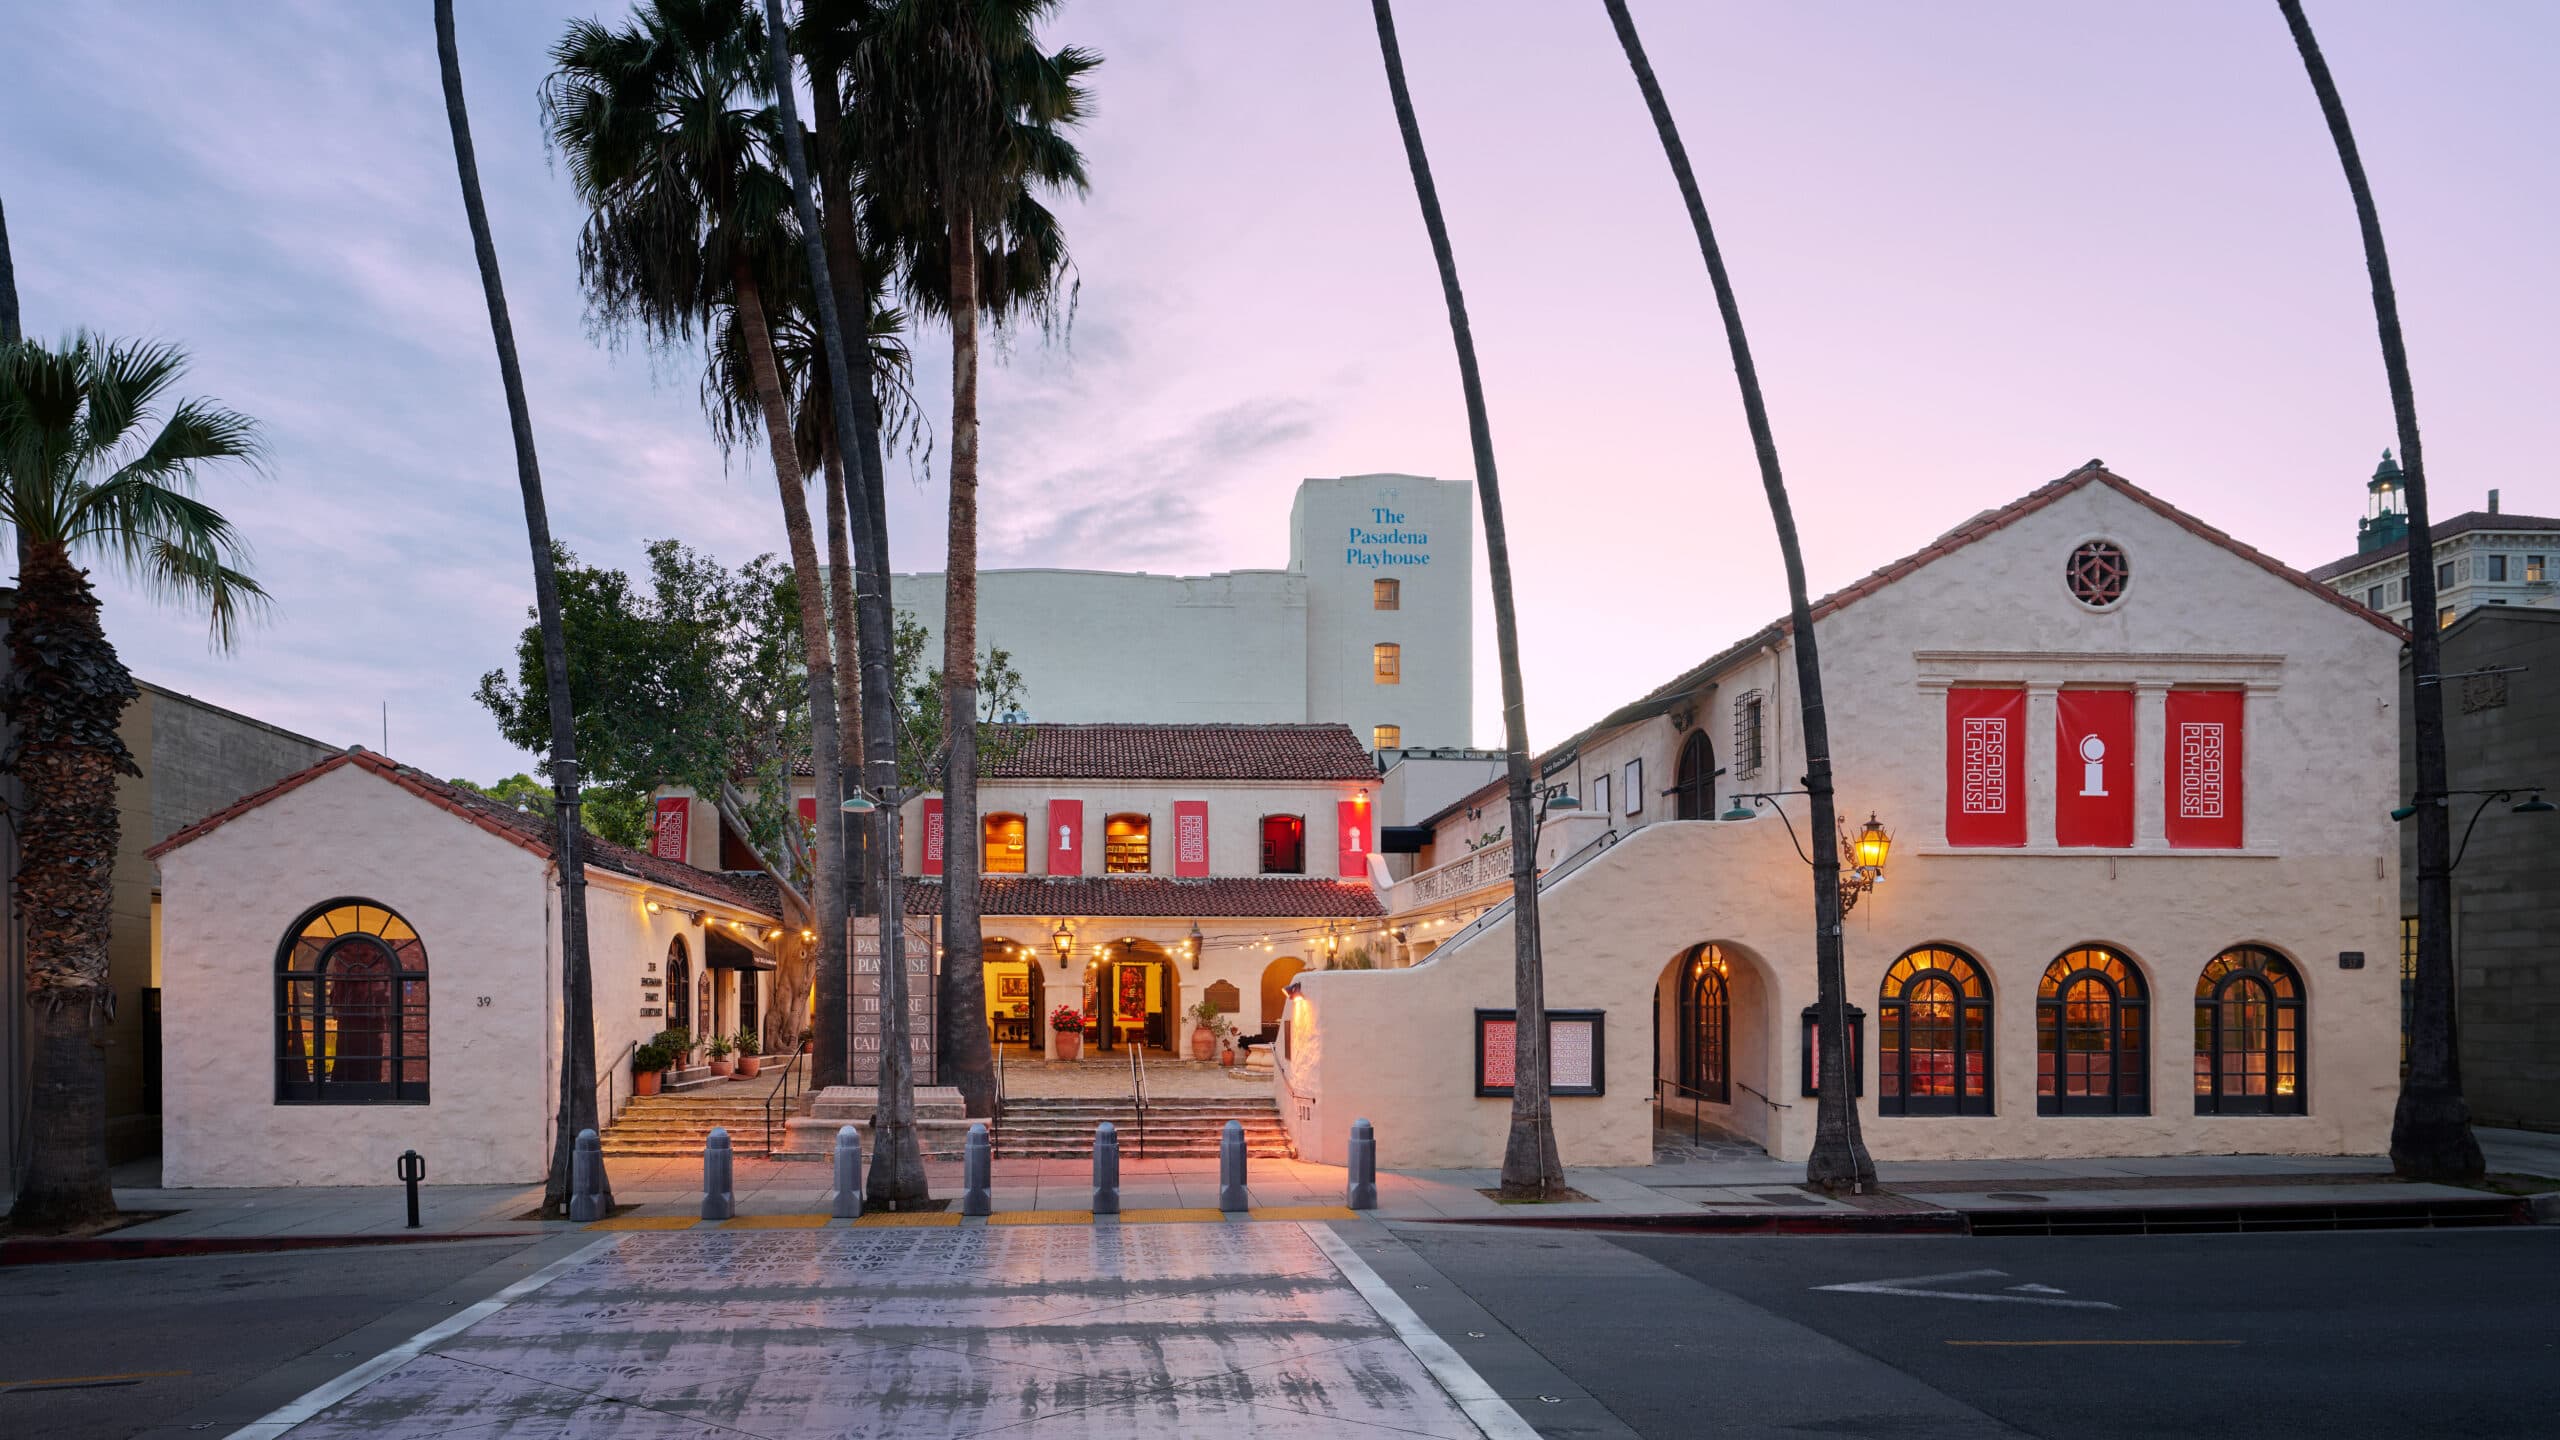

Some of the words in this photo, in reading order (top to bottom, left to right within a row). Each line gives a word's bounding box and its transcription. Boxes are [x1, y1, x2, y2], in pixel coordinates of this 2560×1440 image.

[1372, 508, 1405, 524] The
[1350, 528, 1428, 545] Pasadena
[1347, 549, 1430, 569] Playhouse
[1966, 721, 1983, 810] PLAYHOUSE
[1987, 721, 2003, 810] PASADENA
[2184, 727, 2200, 814] PLAYHOUSE
[2204, 727, 2220, 815] PASADENA
[930, 815, 940, 859] PLAYHOUSE
[857, 939, 928, 953] PASNA
[858, 958, 928, 972] PLAUSE
[477, 996, 491, 1007] 39
[862, 998, 922, 1012] THRE
